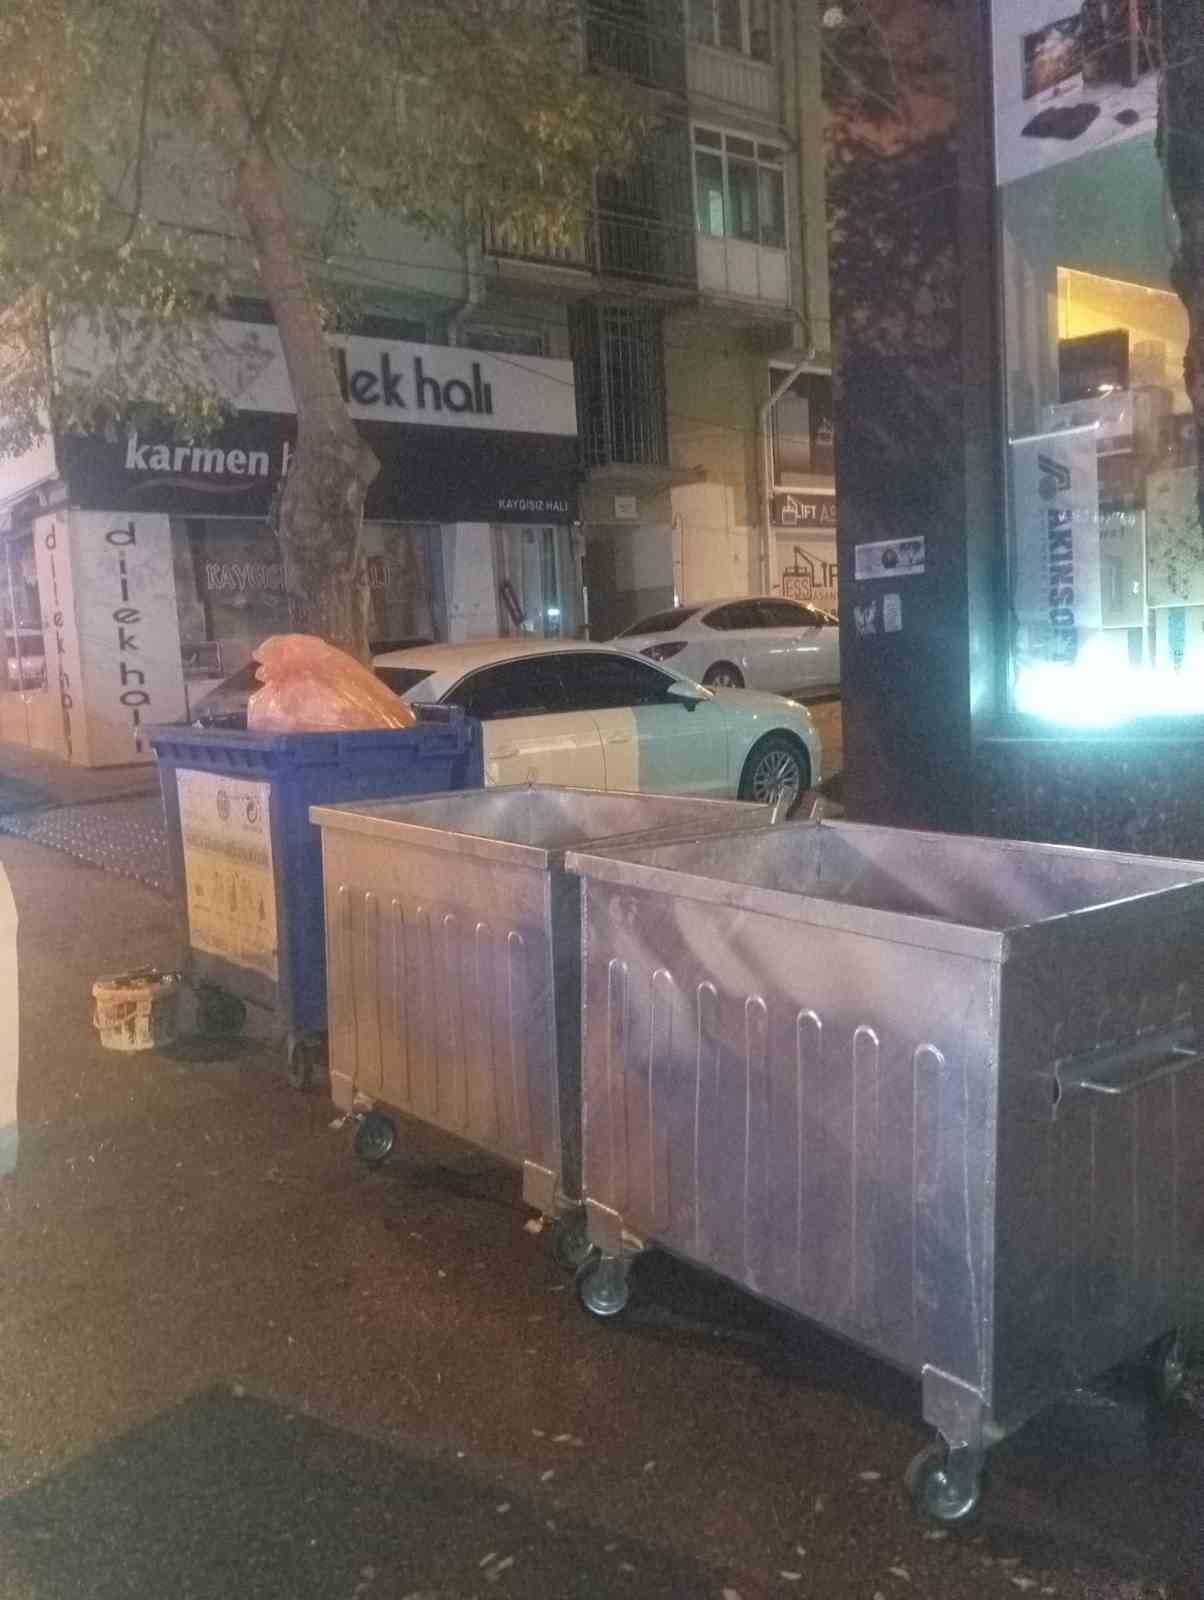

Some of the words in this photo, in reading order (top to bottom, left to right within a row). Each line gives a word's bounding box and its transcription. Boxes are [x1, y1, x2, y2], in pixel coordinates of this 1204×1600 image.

[414, 356, 493, 415] halı
[125, 432, 271, 476] karmen
[795, 503, 817, 520] LIFT
[45, 523, 66, 655] dilek
[105, 521, 141, 650] dilek
[1047, 508, 1079, 664] AKINSOFT
